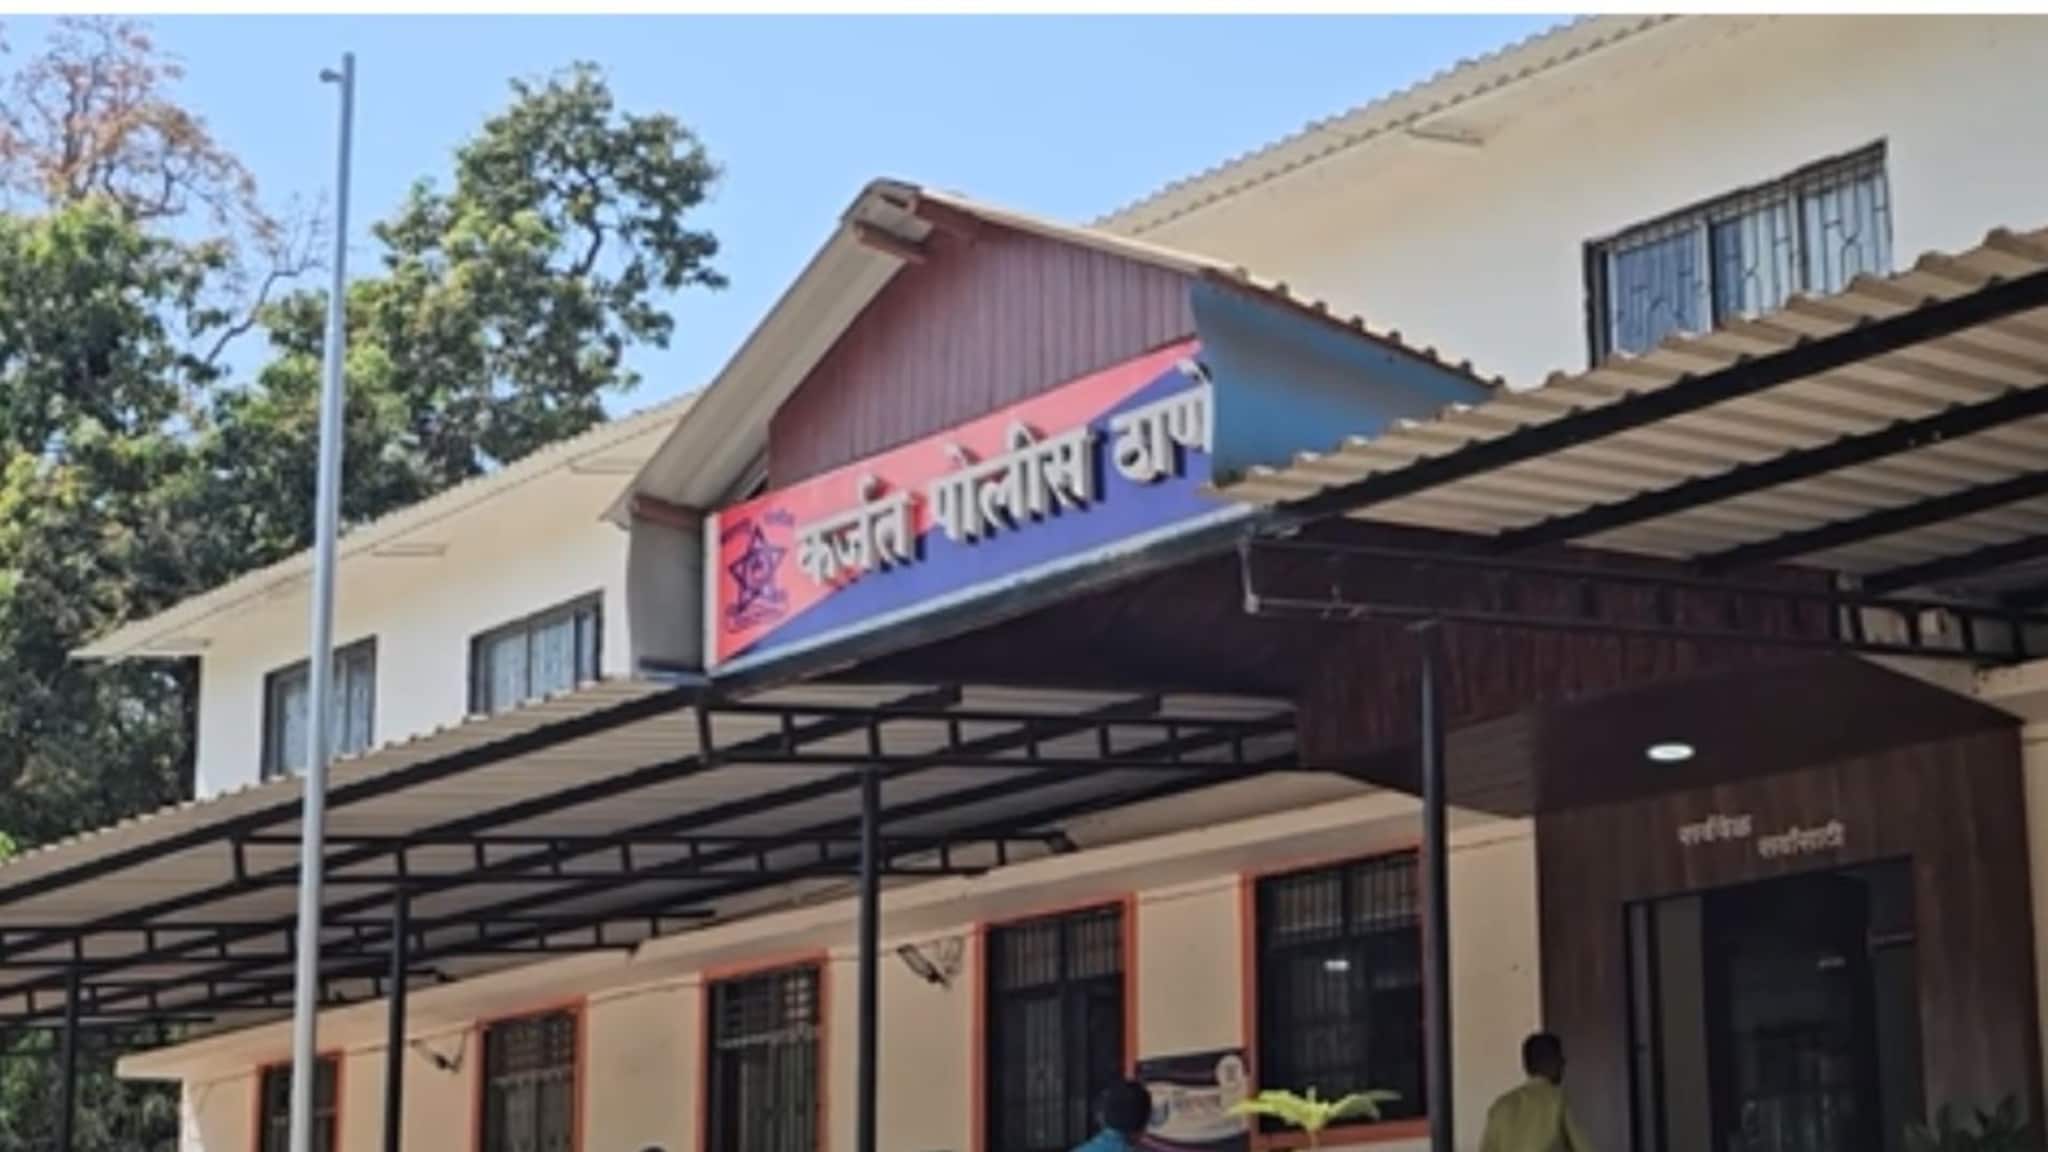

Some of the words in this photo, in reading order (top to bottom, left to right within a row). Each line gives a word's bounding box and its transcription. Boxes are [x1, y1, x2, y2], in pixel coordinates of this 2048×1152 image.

[798, 474, 914, 584] कर्जत
[929, 417, 1097, 541] पोलीस
[1111, 359, 1214, 481] ठाणे
